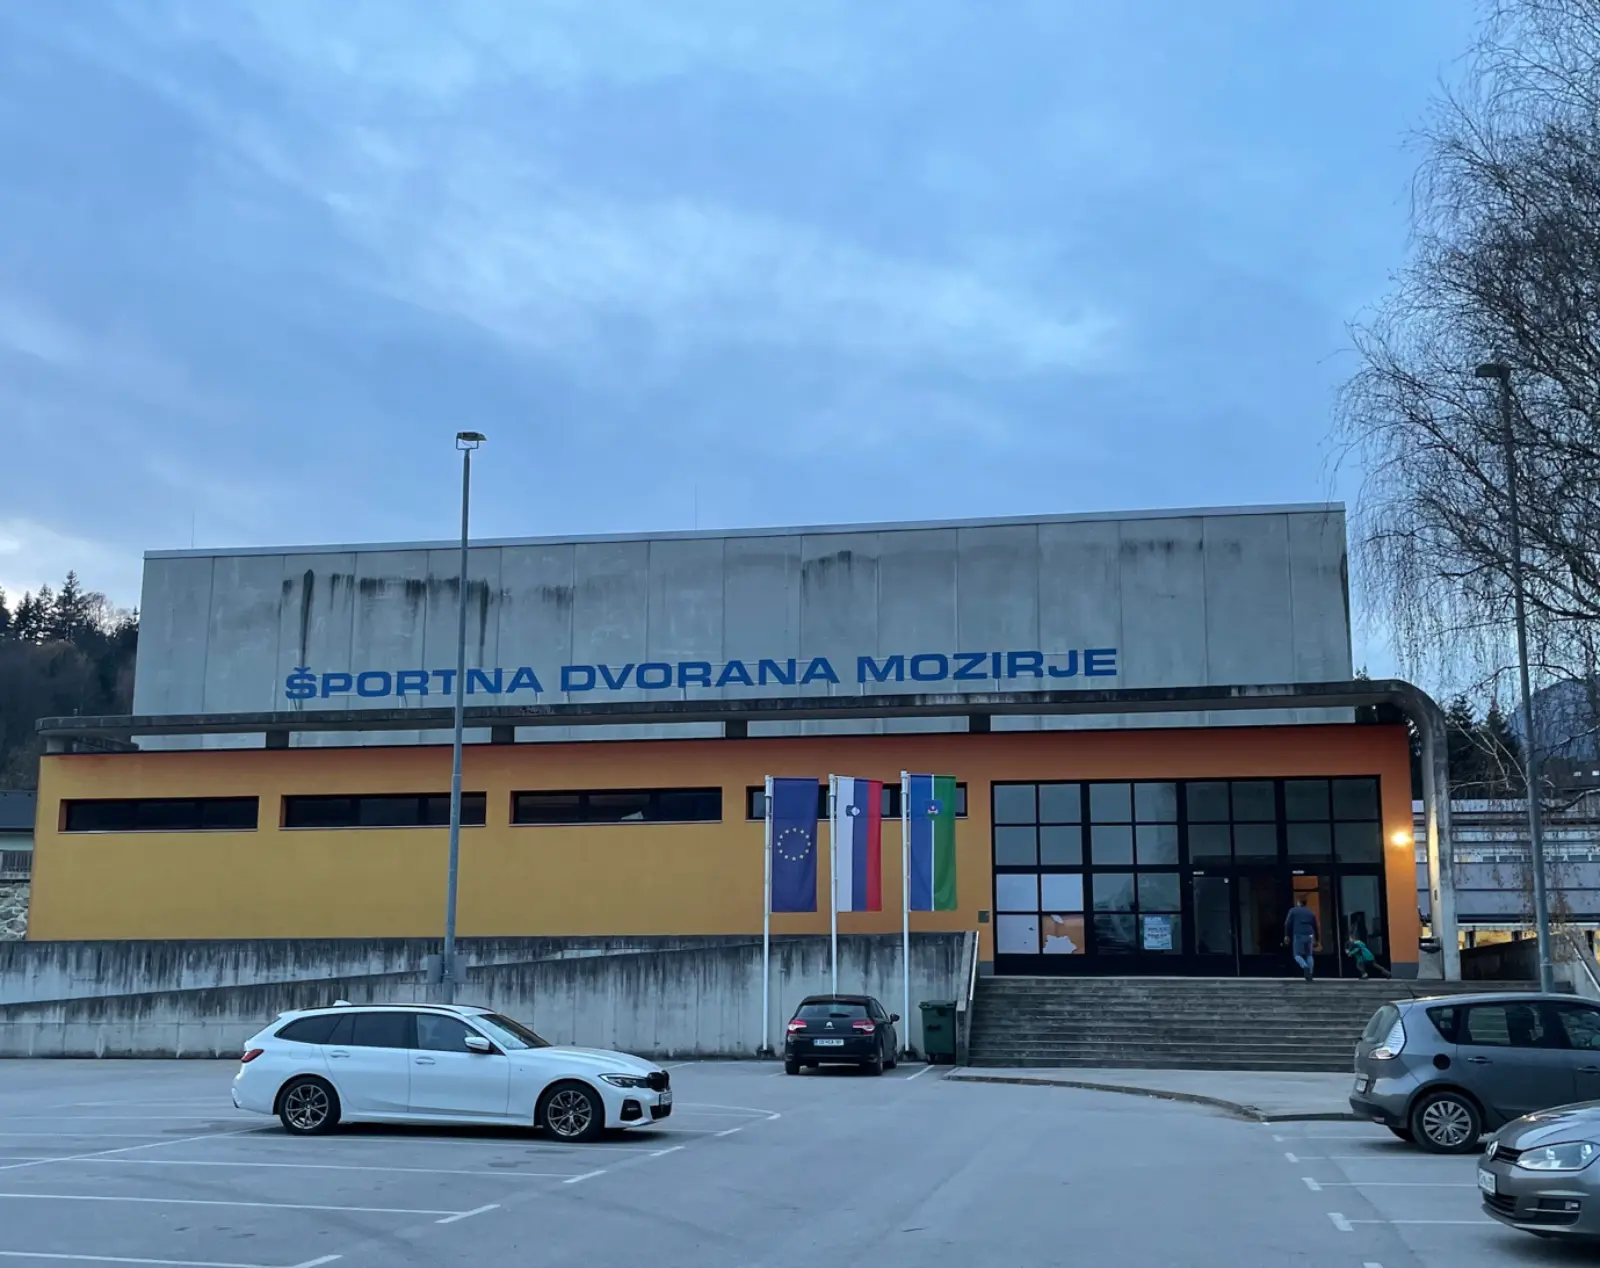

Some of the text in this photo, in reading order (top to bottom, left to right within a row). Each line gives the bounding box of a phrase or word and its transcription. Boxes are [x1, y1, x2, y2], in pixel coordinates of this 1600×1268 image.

[285, 648, 1117, 700] ŠPORTNA DVORANA MOZIRJE
